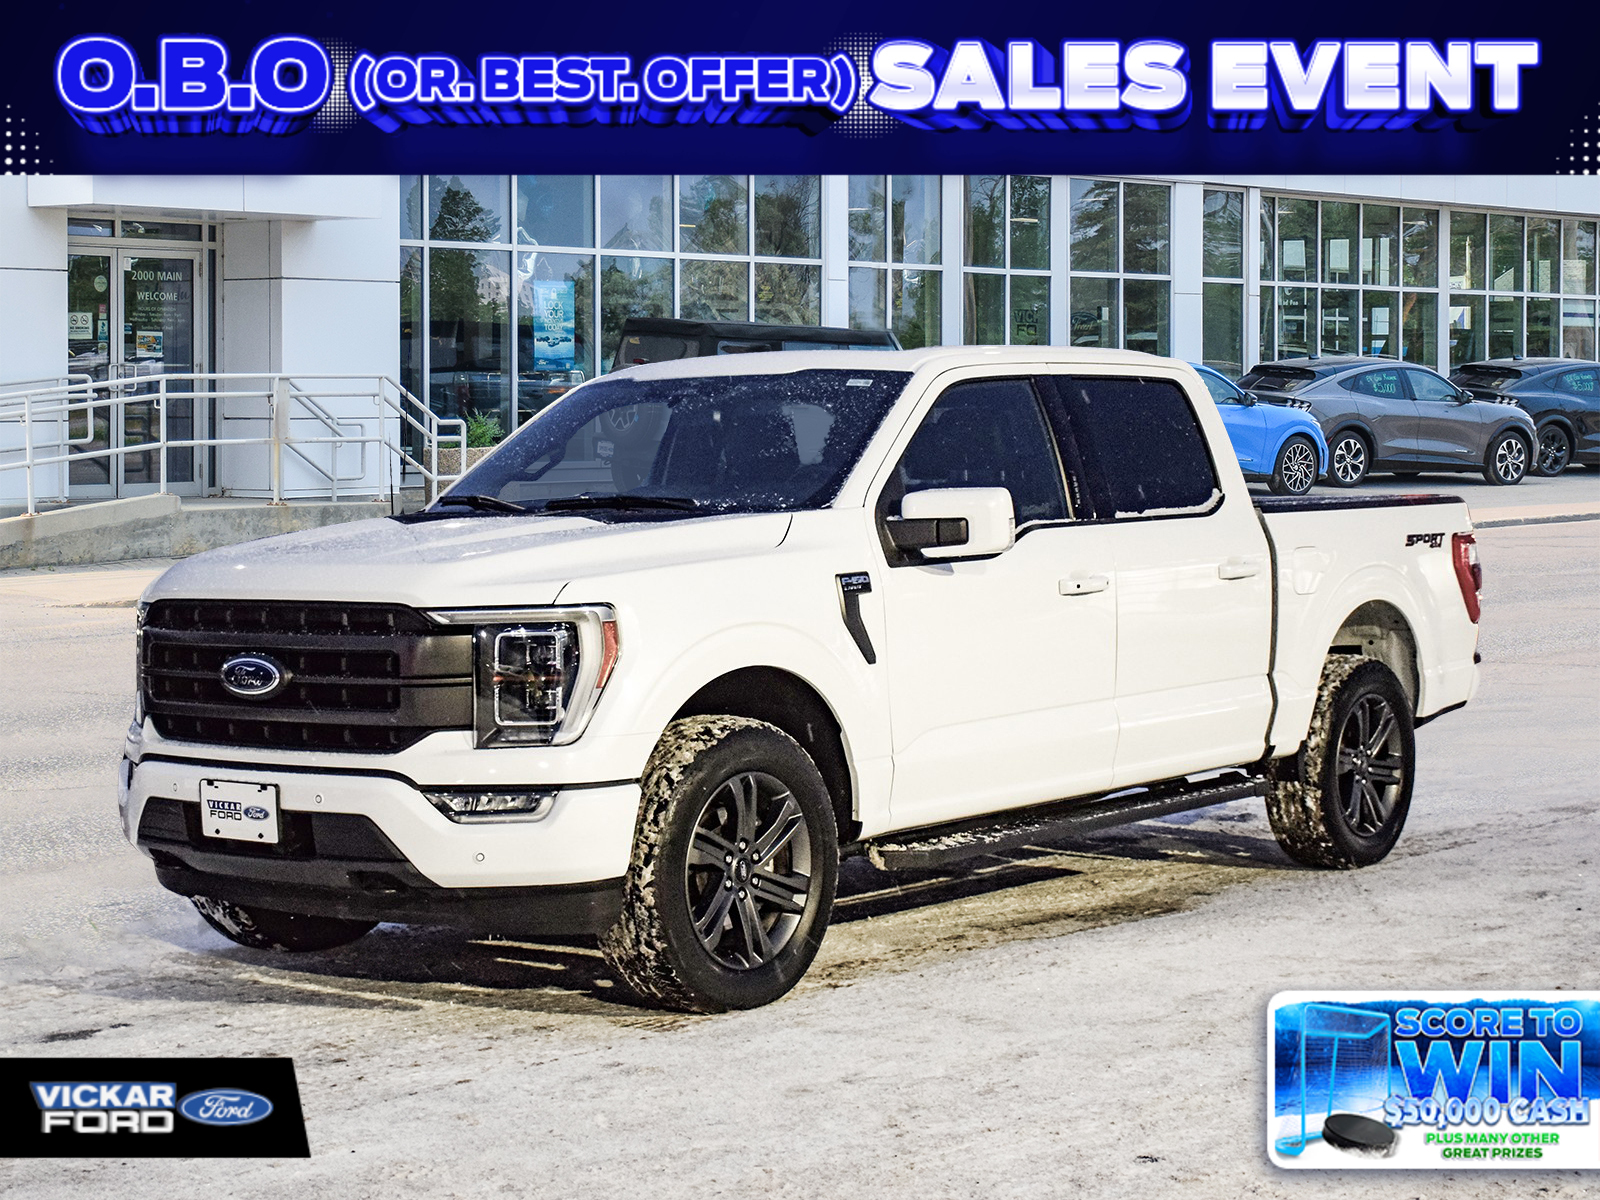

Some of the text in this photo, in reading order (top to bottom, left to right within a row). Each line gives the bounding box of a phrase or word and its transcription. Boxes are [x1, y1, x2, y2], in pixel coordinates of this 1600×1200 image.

[131, 271, 183, 281] 2000 MAIN
[137, 291, 178, 301] WELCOME
[1405, 533, 1445, 547] SPORT
[208, 801, 242, 811] VICKAR
[209, 810, 242, 821] FORD
[247, 806, 266, 819] Ford
